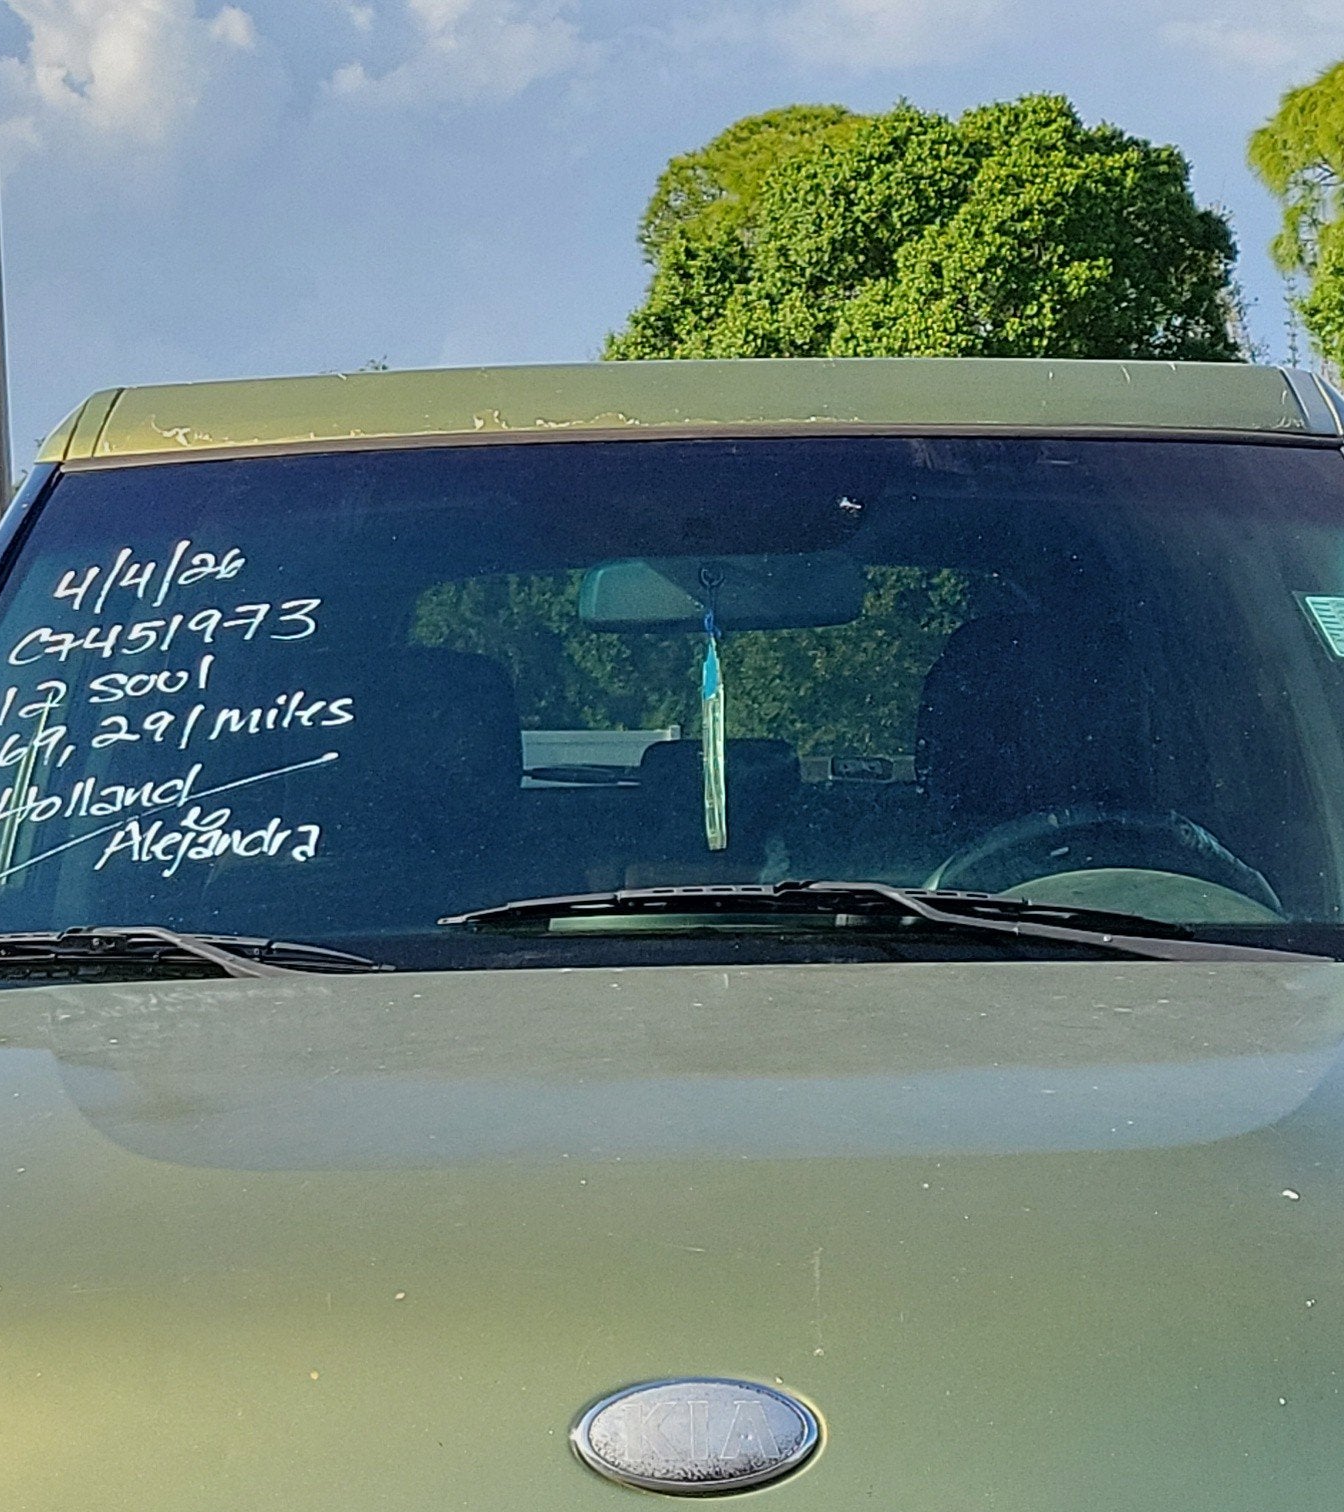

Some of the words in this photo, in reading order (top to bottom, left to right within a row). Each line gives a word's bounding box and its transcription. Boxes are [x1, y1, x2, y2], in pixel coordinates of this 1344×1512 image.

[54, 540, 246, 614] 4/4/26
[93, 806, 320, 877] Alejandra
[624, 1400, 782, 1461] KIA
